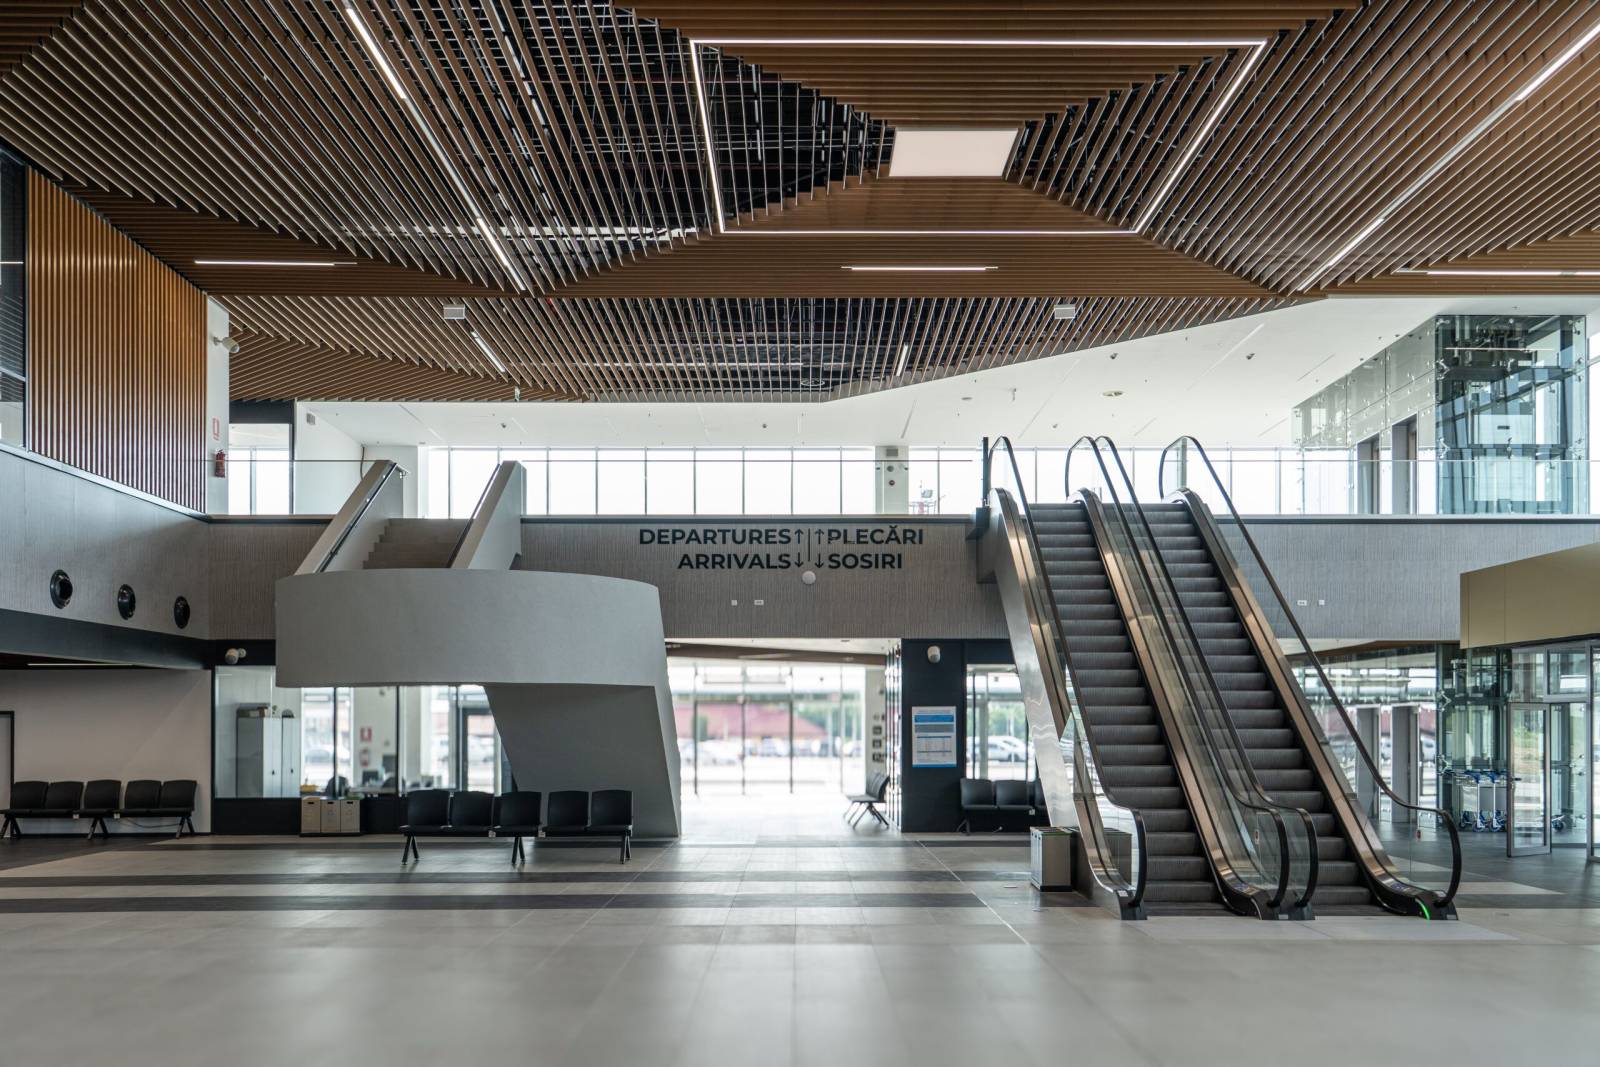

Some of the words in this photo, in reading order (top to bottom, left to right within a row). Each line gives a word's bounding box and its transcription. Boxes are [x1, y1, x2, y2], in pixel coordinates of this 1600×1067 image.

[639, 528, 792, 545] DEPARTURES
[827, 525, 924, 545] PLECĂRI
[677, 553, 791, 569] ARRIVALS
[827, 553, 903, 569] SOSIRI
